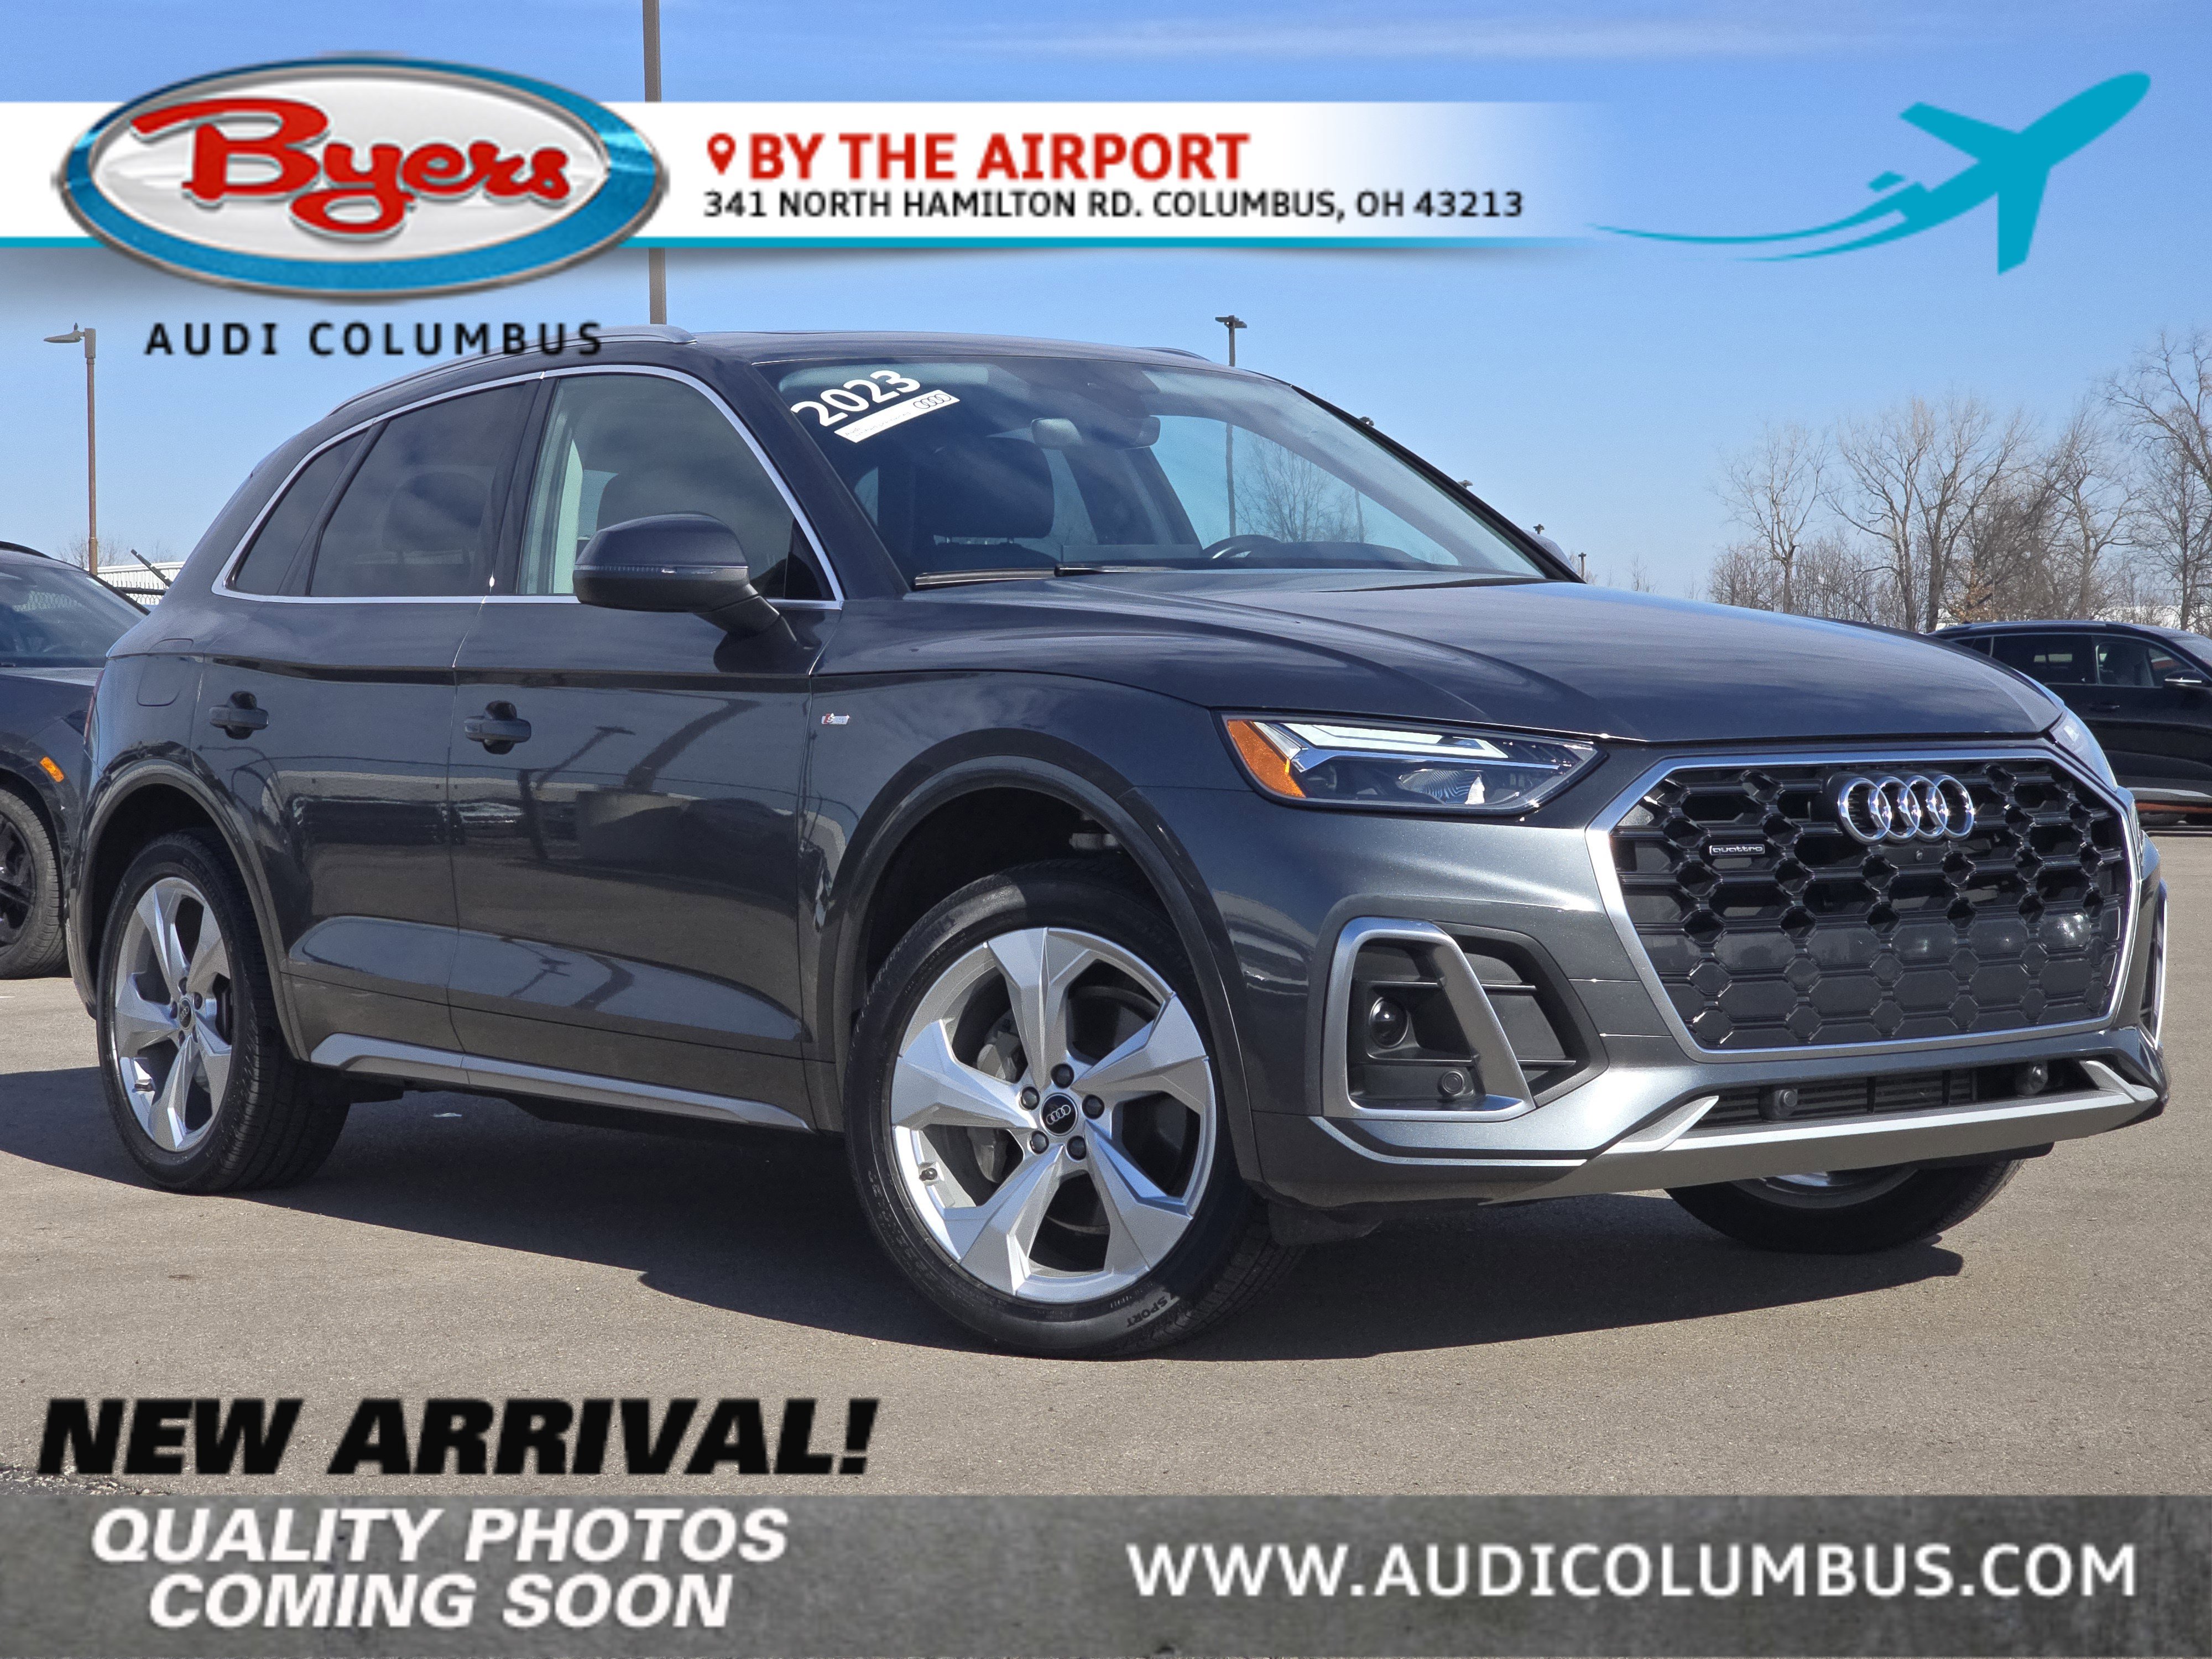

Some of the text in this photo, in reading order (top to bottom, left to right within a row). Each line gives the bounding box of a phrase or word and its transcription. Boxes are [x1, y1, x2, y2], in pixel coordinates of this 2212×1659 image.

[790, 370, 921, 427] 2023
[1712, 846, 1763, 854] quattro
[1126, 1296, 1169, 1328] SPORT
